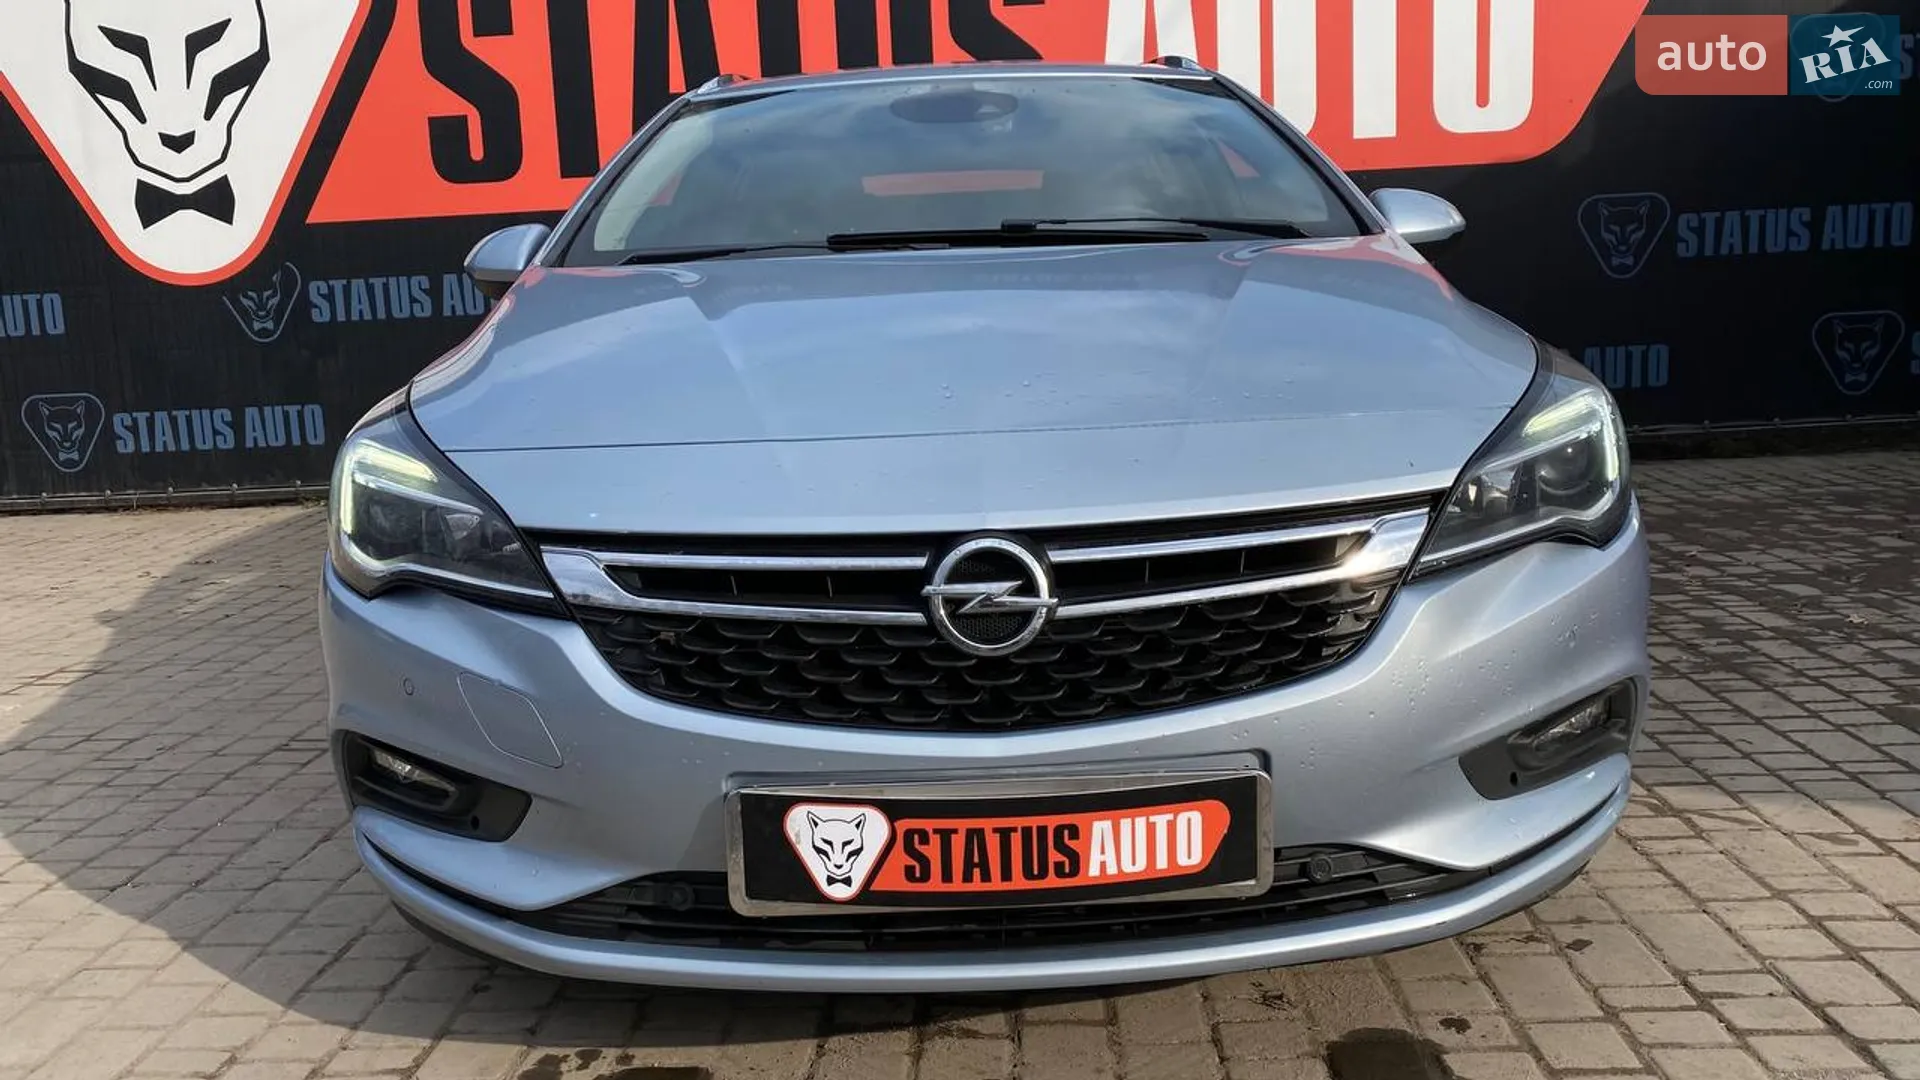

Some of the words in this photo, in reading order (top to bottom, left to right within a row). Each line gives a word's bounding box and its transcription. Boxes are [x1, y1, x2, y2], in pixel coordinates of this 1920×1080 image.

[1676, 207, 1811, 259] STATUS
[1820, 201, 1914, 251] AUTO
[0, 292, 66, 338] UTO
[309, 275, 433, 323] STATUS
[442, 272, 492, 317] AU
[112, 408, 236, 454] STATUS
[245, 403, 327, 448] AUTO
[903, 821, 1081, 885] STATUS
[1088, 809, 1203, 878] AUTO
